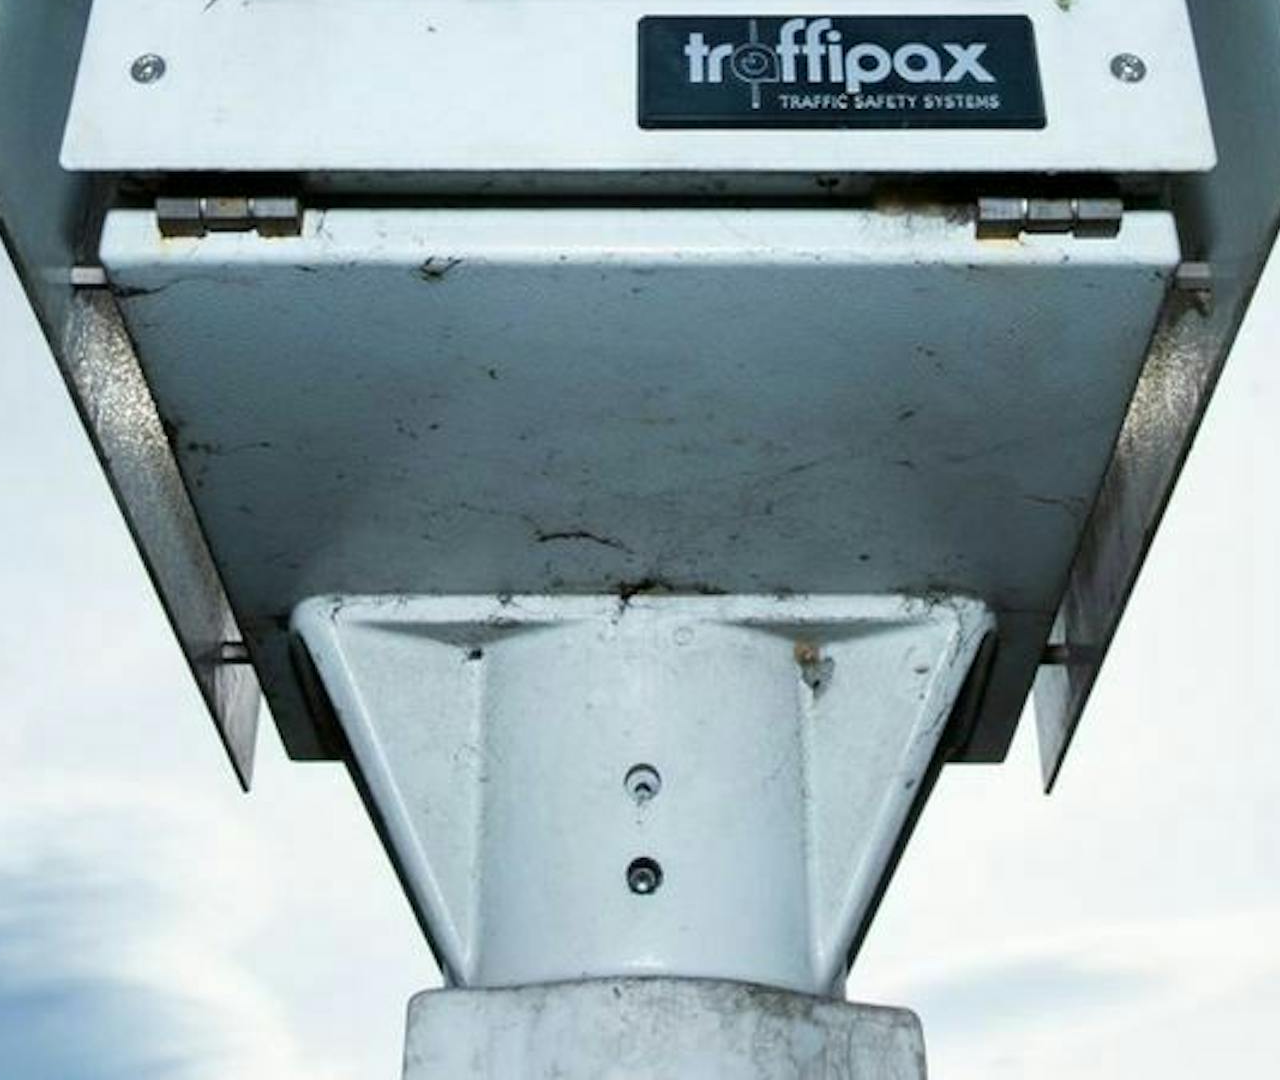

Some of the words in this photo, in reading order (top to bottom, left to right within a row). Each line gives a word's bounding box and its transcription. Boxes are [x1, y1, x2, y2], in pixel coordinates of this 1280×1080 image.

[684, 17, 995, 94] traffipax
[780, 94, 849, 110] TRAFFIC
[854, 94, 917, 110] SAFETY
[924, 94, 1000, 110] SYSTEMS
